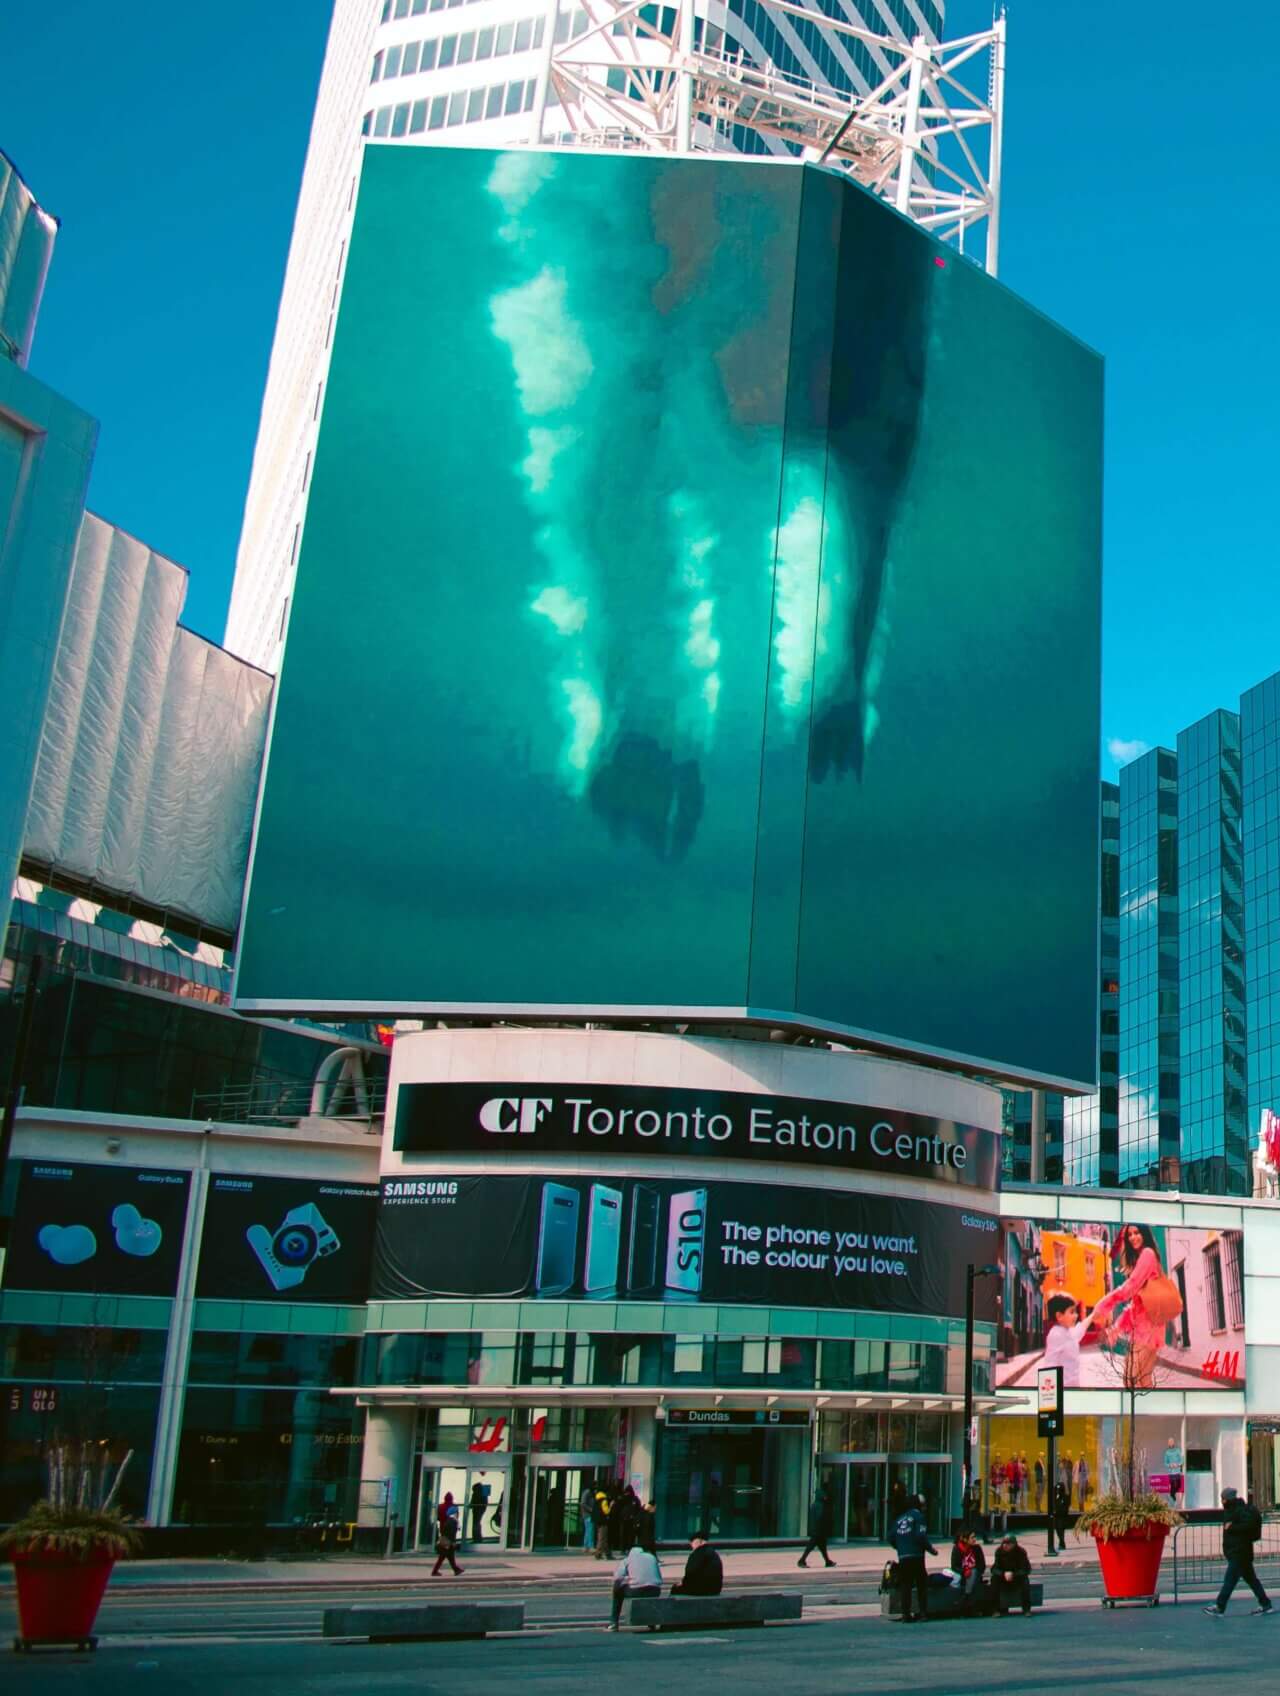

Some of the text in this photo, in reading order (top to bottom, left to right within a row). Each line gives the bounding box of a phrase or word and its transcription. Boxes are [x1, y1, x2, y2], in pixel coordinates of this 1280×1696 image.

[480, 1098, 967, 1169] CF Toronto Eaton Centre
[384, 1182, 458, 1196] SAMSUNG
[677, 1208, 701, 1273] S10
[722, 1221, 919, 1254] The phone you want.
[721, 1245, 908, 1276] The colour you love.
[1200, 1350, 1240, 1384] H&M
[688, 1410, 730, 1422] Dundas
